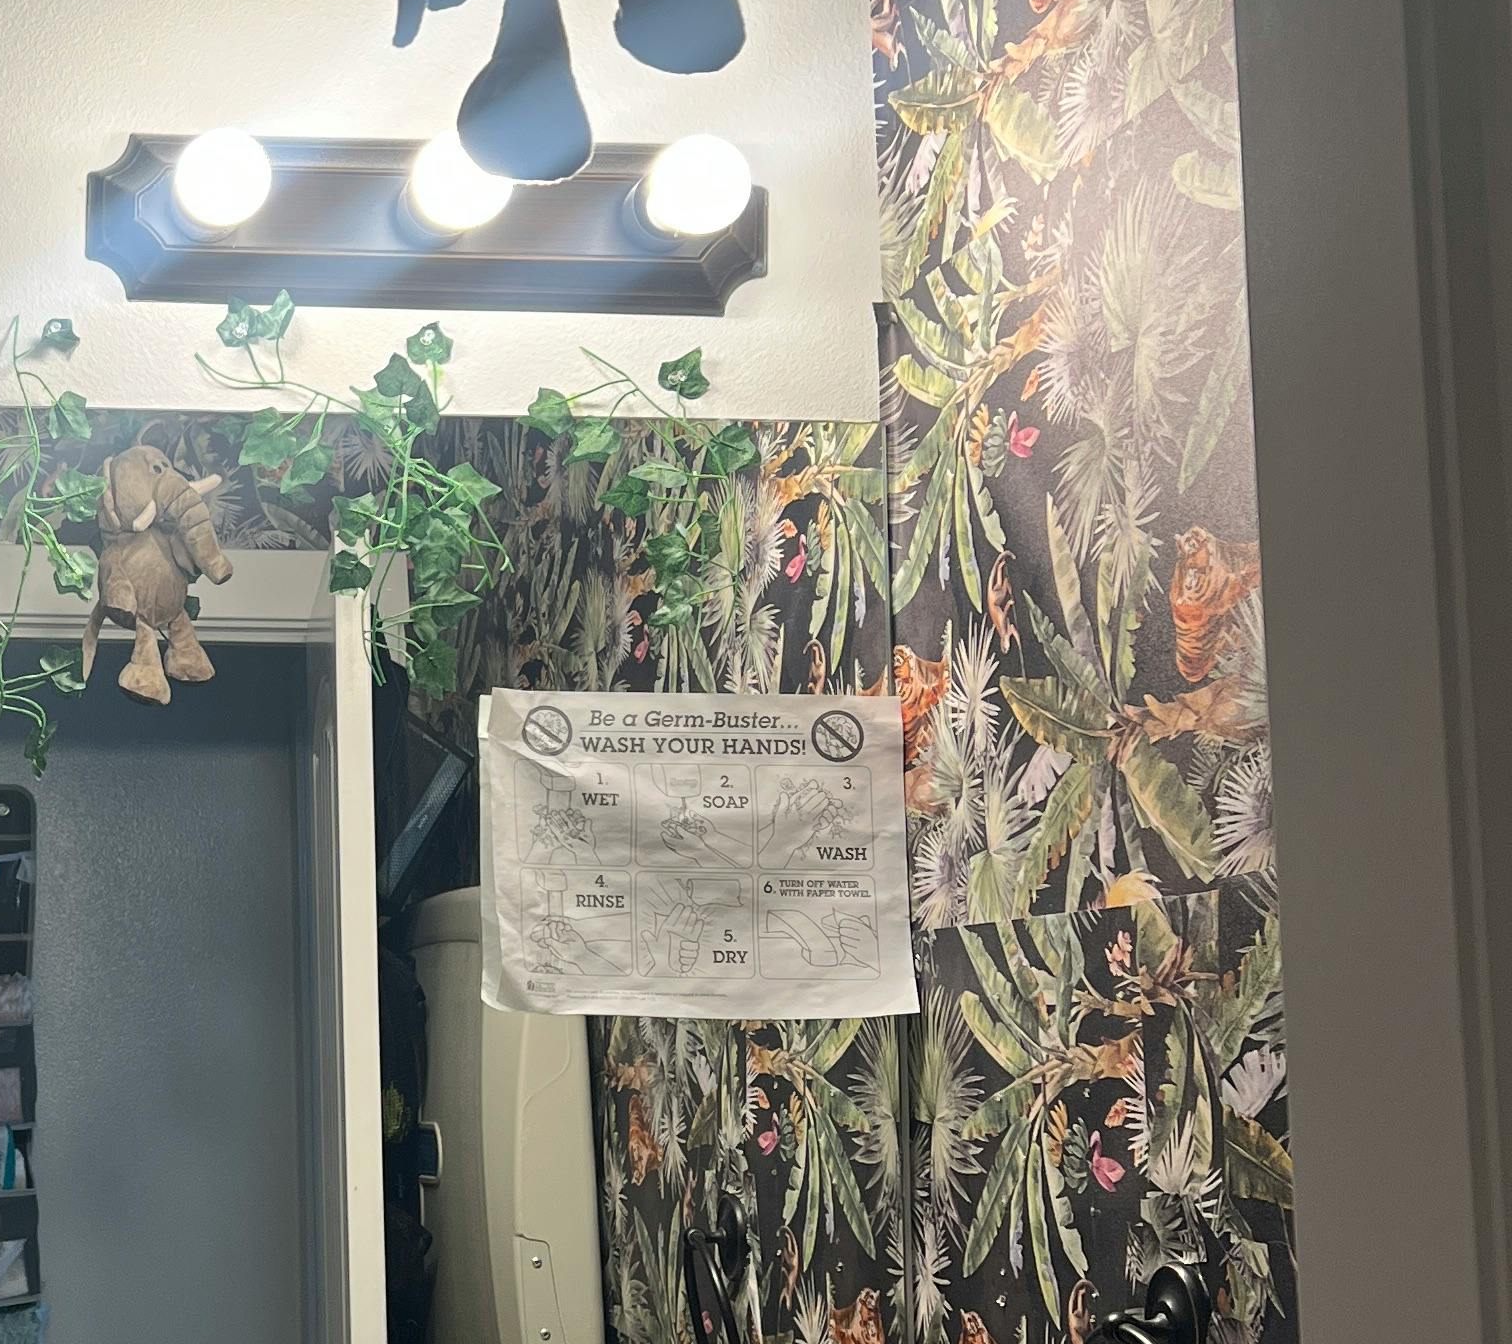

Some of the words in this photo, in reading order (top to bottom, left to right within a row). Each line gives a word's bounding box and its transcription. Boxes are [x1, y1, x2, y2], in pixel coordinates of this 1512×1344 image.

[588, 710, 615, 727] Be
[623, 714, 638, 727] a
[644, 711, 799, 730] Germ-Buster...
[579, 737, 645, 753] WASH
[653, 737, 715, 754] YOUR
[722, 738, 806, 756] HANDS!
[597, 772, 608, 786] 1.
[720, 775, 734, 788] 2.
[842, 776, 856, 791] 3.
[582, 792, 619, 807] WET
[702, 796, 749, 809] SOAP
[816, 846, 867, 861] WASH
[594, 875, 609, 888] 4.
[763, 880, 777, 895] 6.
[779, 880, 804, 888] TURN
[806, 880, 824, 888] OFF
[826, 880, 859, 889] WATER
[779, 889, 805, 897] WITH
[575, 894, 625, 909] RINSE
[723, 929, 737, 944] 5.
[713, 950, 748, 965] DRY
